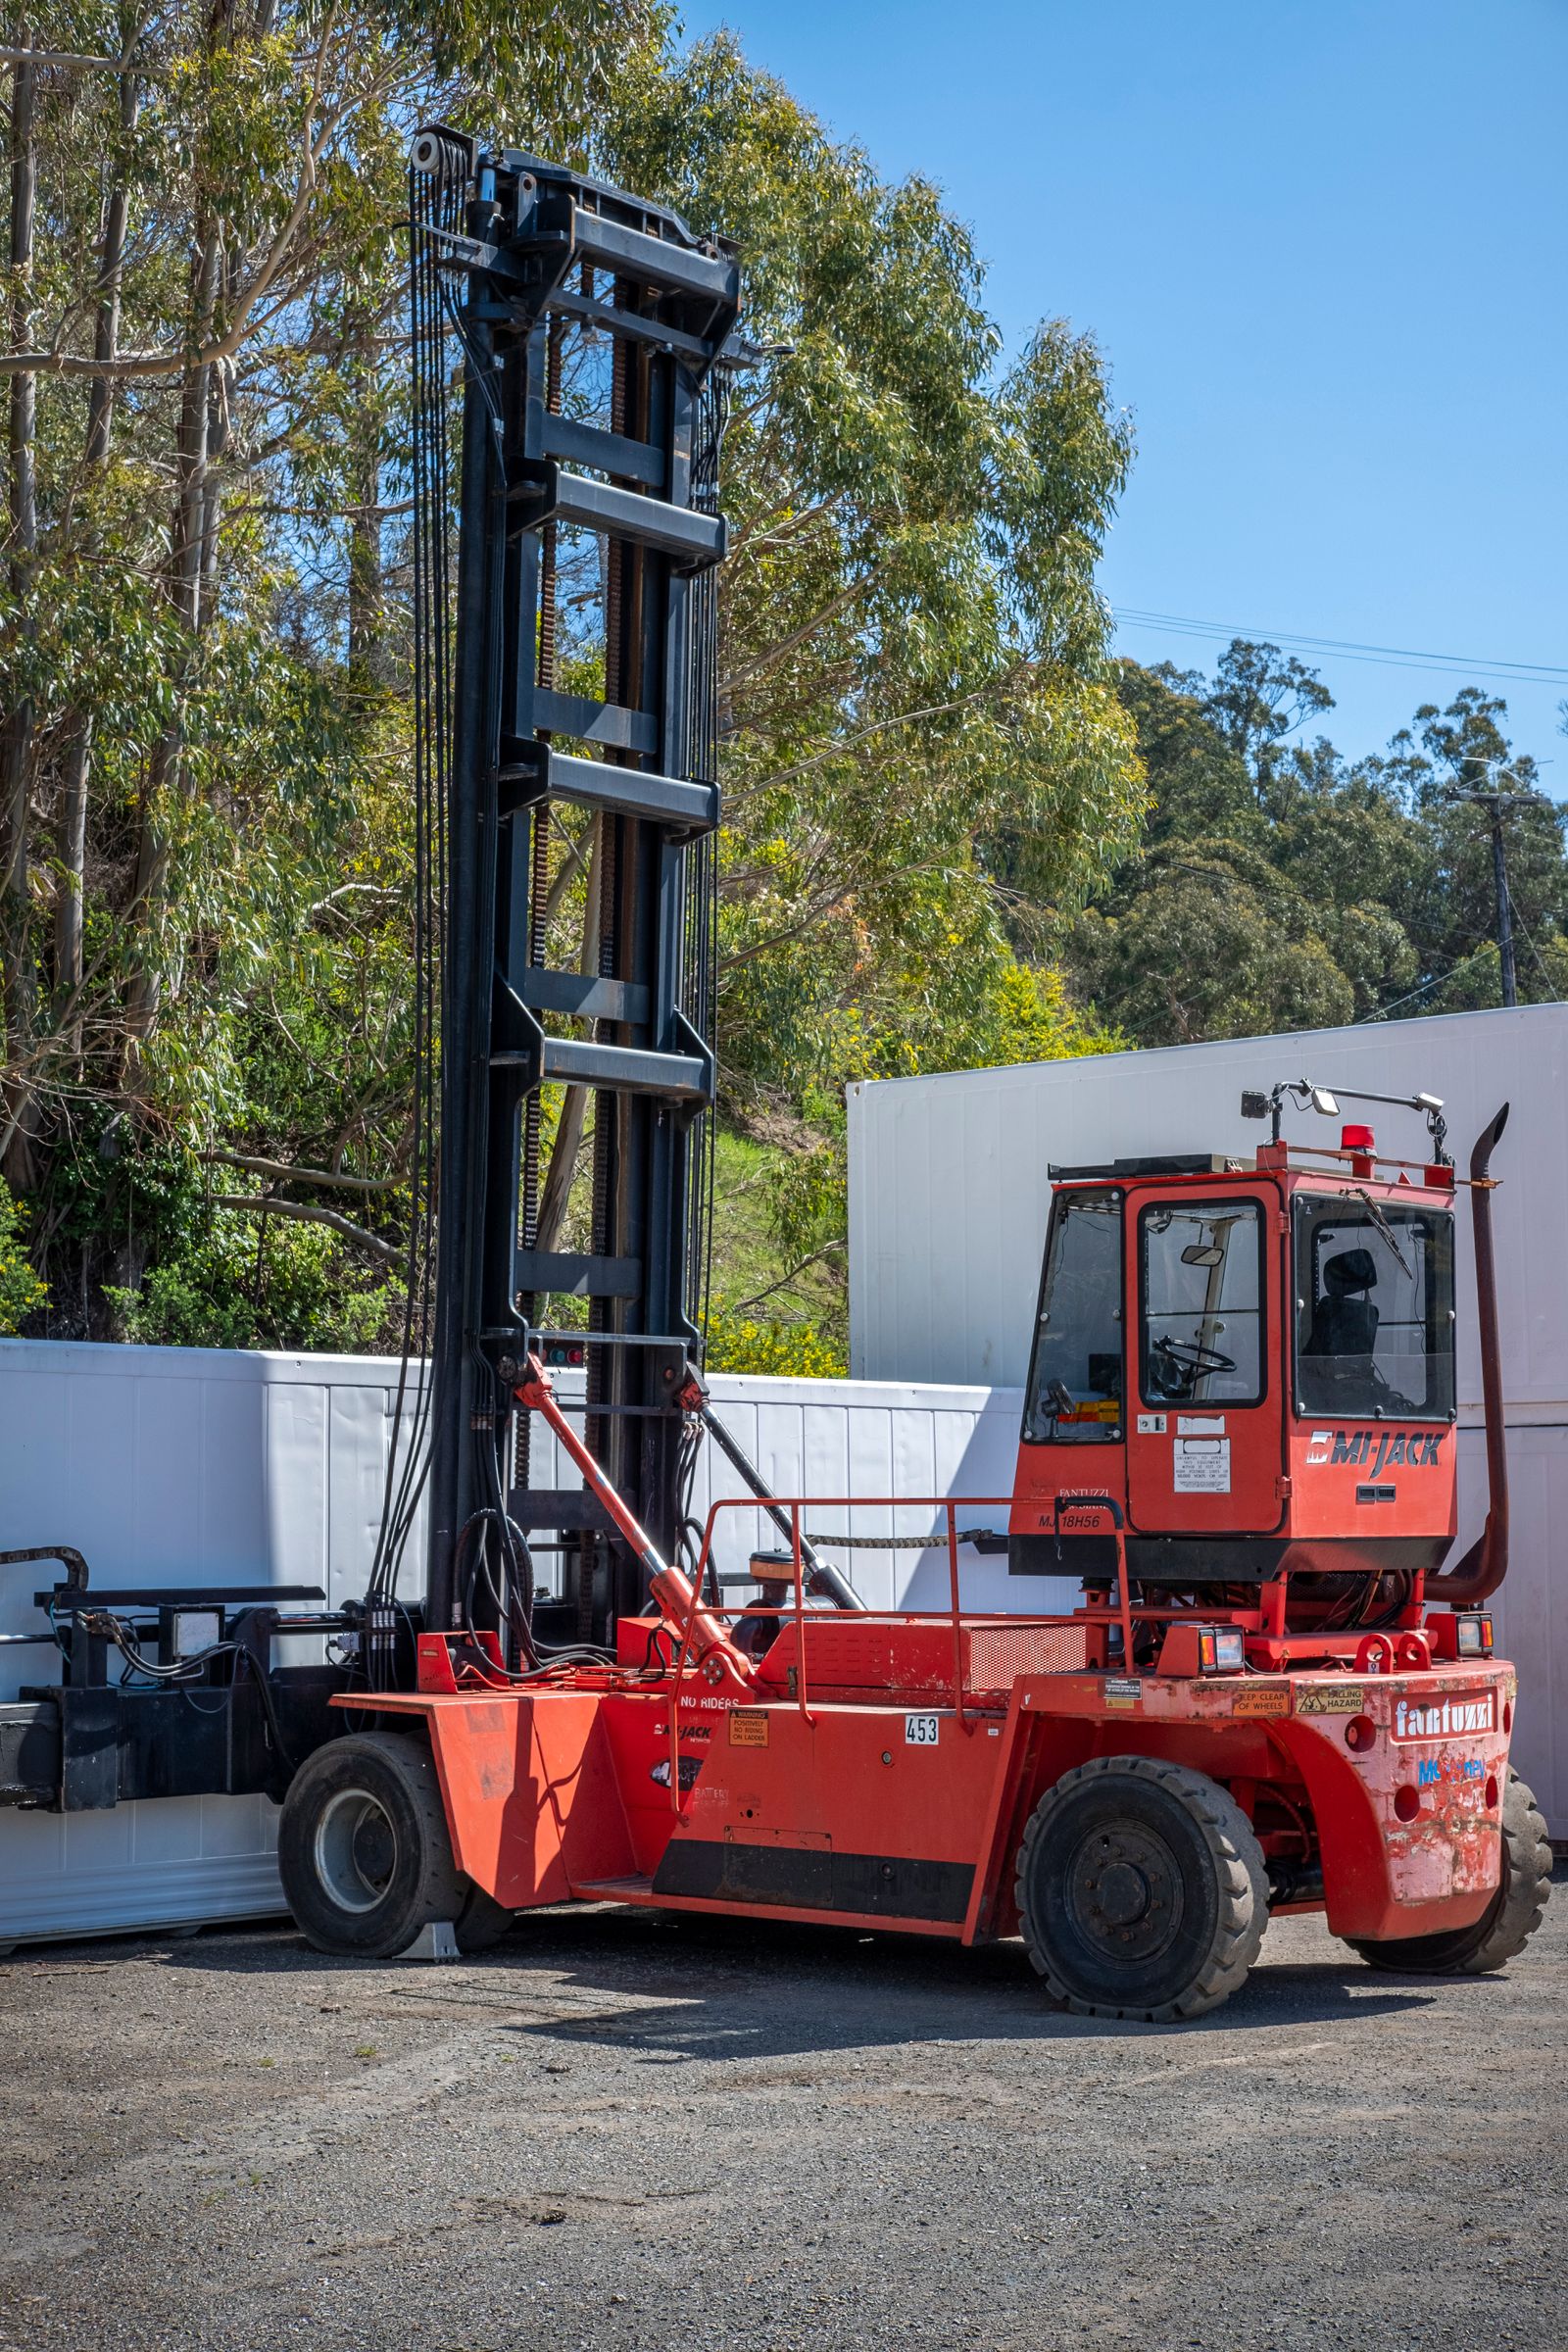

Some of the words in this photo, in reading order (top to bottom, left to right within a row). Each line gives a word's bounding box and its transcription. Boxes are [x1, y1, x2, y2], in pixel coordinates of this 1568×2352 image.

[1331, 1431, 1445, 1479] MI-JACK
[1059, 1489, 1109, 1498] FANTUZZI
[1062, 1515, 1101, 1528] 18H56
[680, 1696, 696, 1707] NO
[701, 1697, 739, 1709] RIDERS
[1396, 1692, 1493, 1737] fantuzzi
[906, 1718, 937, 1742] 453
